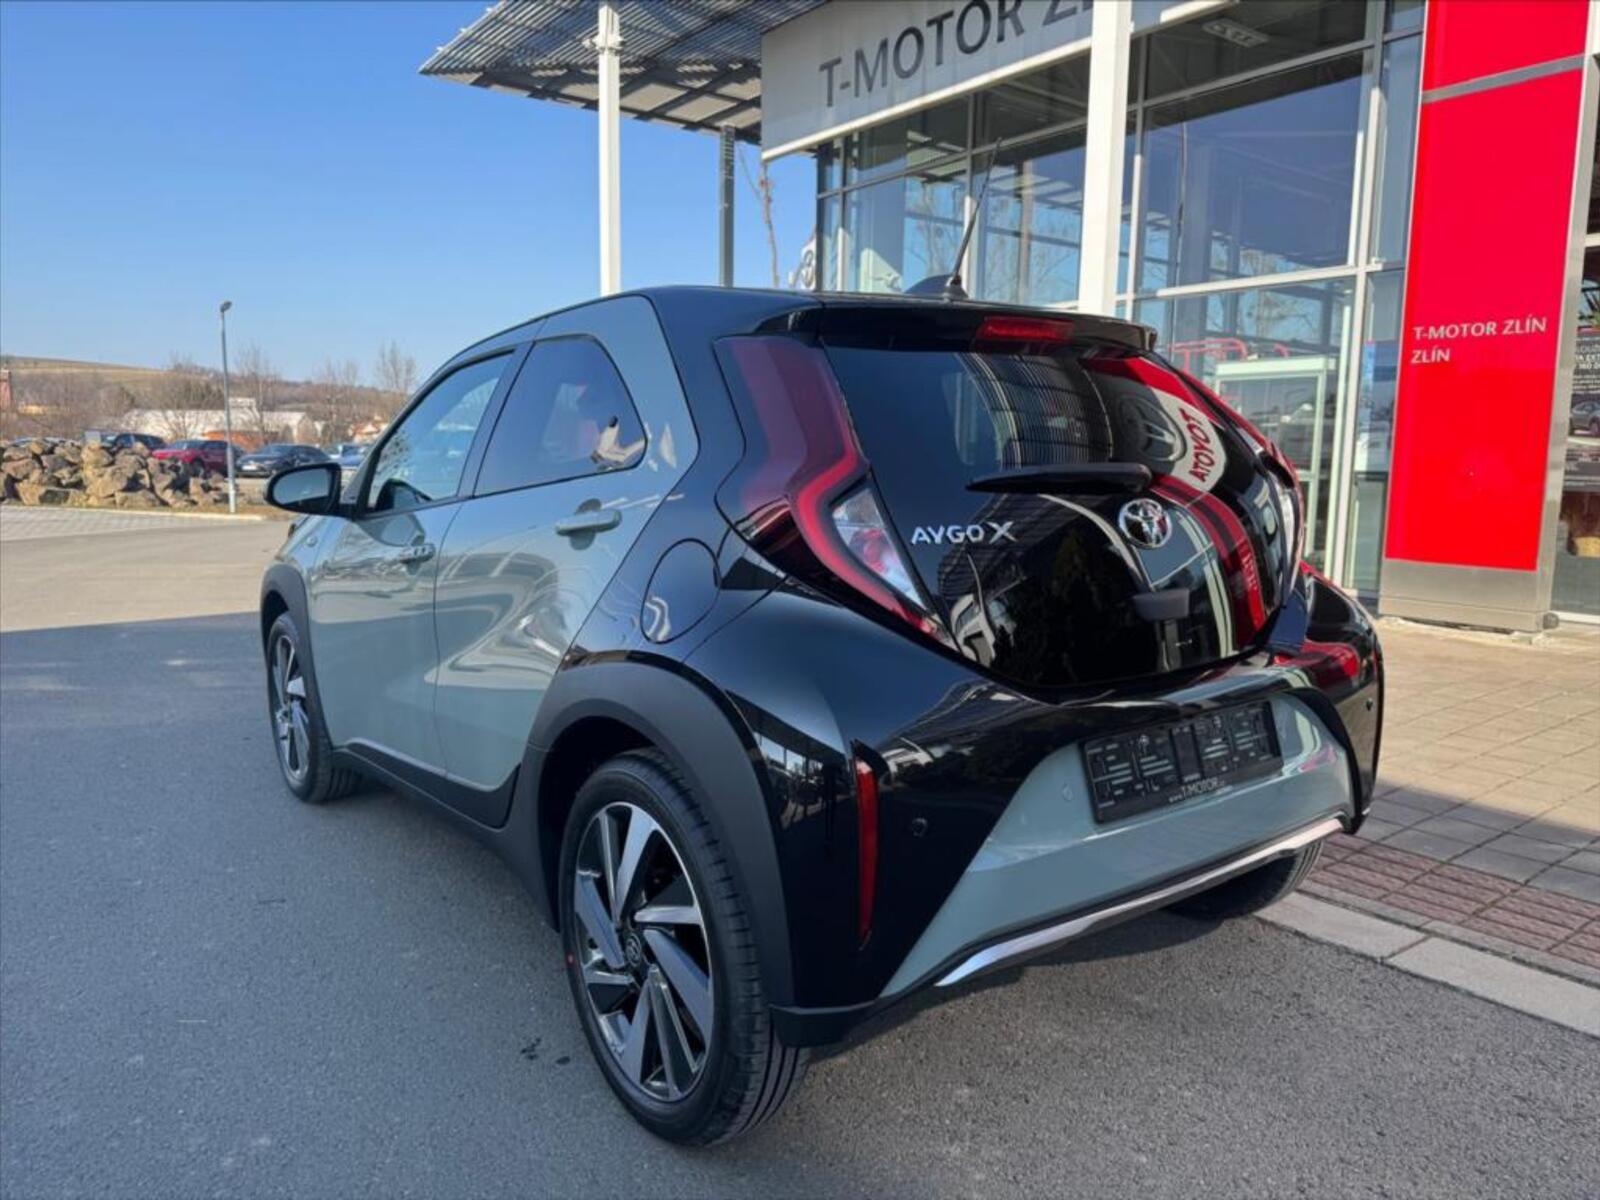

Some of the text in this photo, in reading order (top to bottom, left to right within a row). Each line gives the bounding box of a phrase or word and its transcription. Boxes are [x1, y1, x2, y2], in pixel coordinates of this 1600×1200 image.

[819, 0, 1025, 107] T-MOTOR
[1412, 314, 1547, 341] T-MOTOR ZLÍN
[1411, 345, 1451, 364] ZLÍN
[911, 520, 1018, 545] AYGO X
